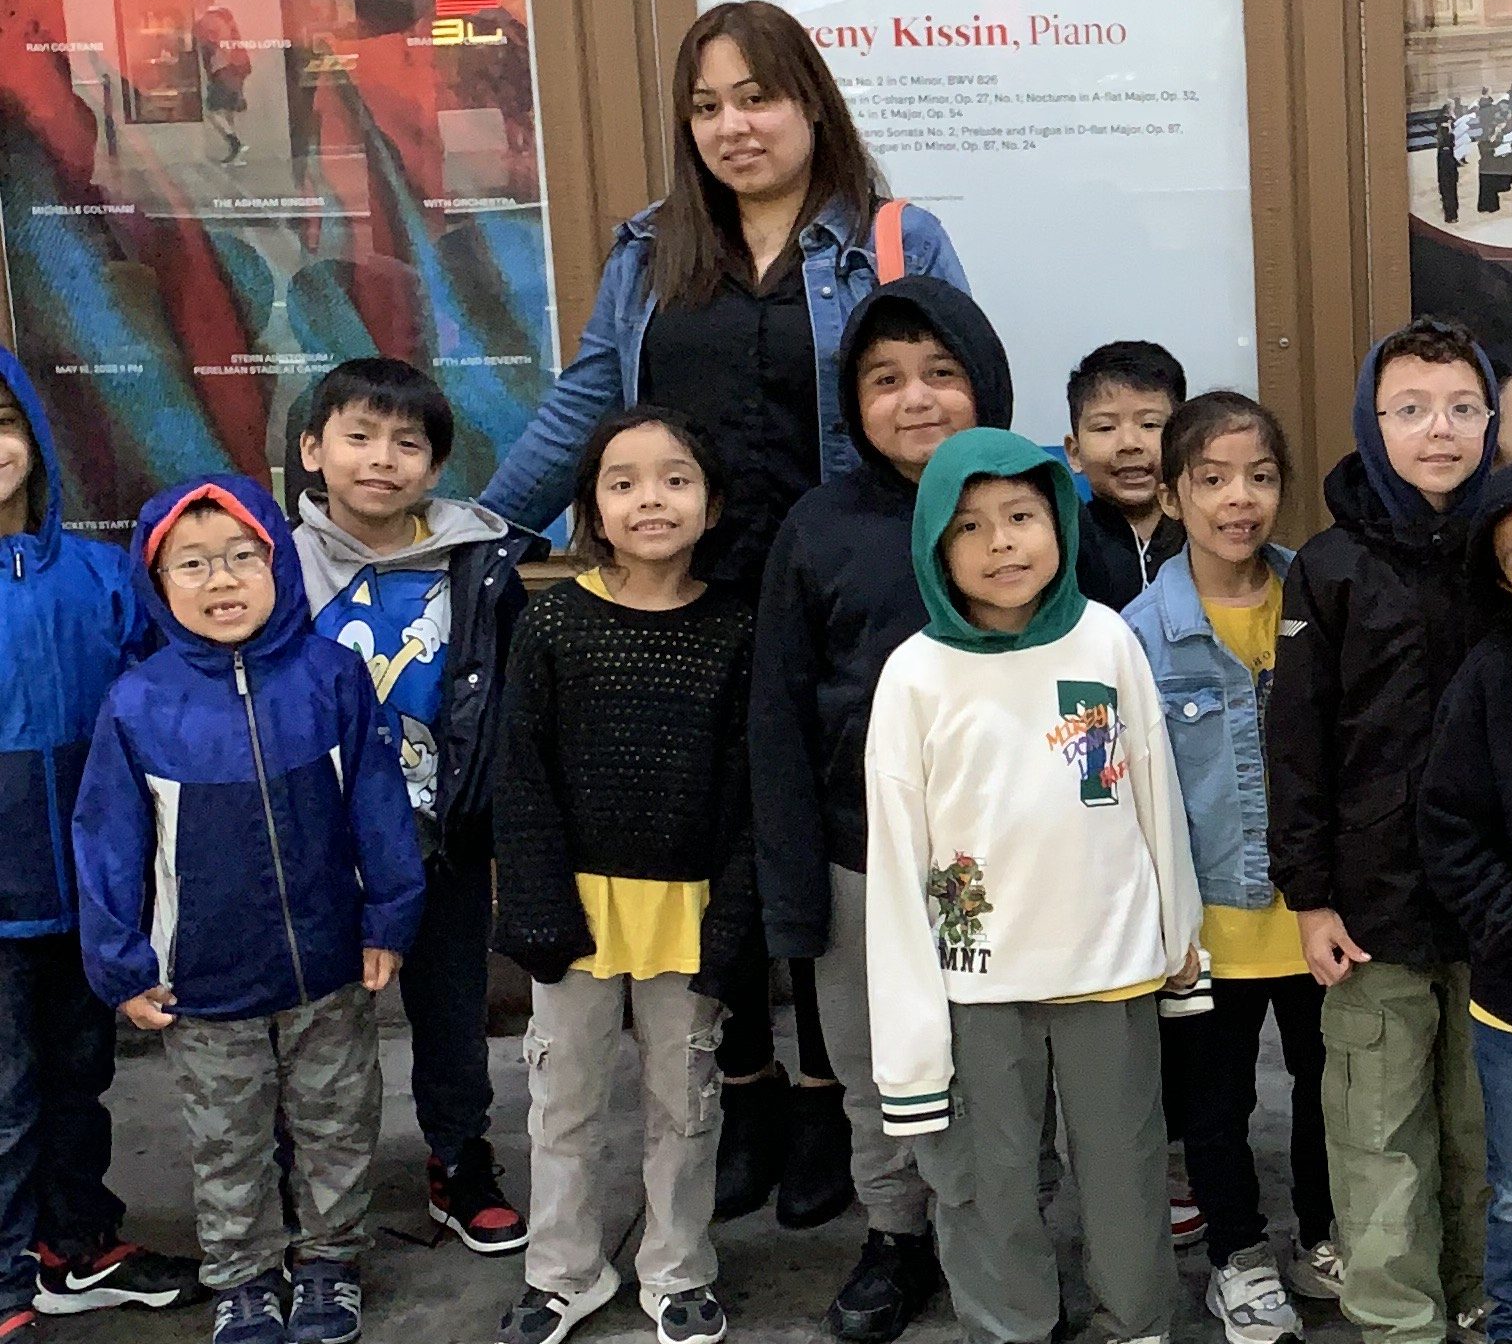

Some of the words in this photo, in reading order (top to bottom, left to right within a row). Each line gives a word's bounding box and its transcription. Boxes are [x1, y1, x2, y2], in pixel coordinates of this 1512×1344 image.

[889, 14, 1021, 52] Kissin,
[1028, 13, 1127, 46] Piano
[939, 946, 992, 974] MNT
